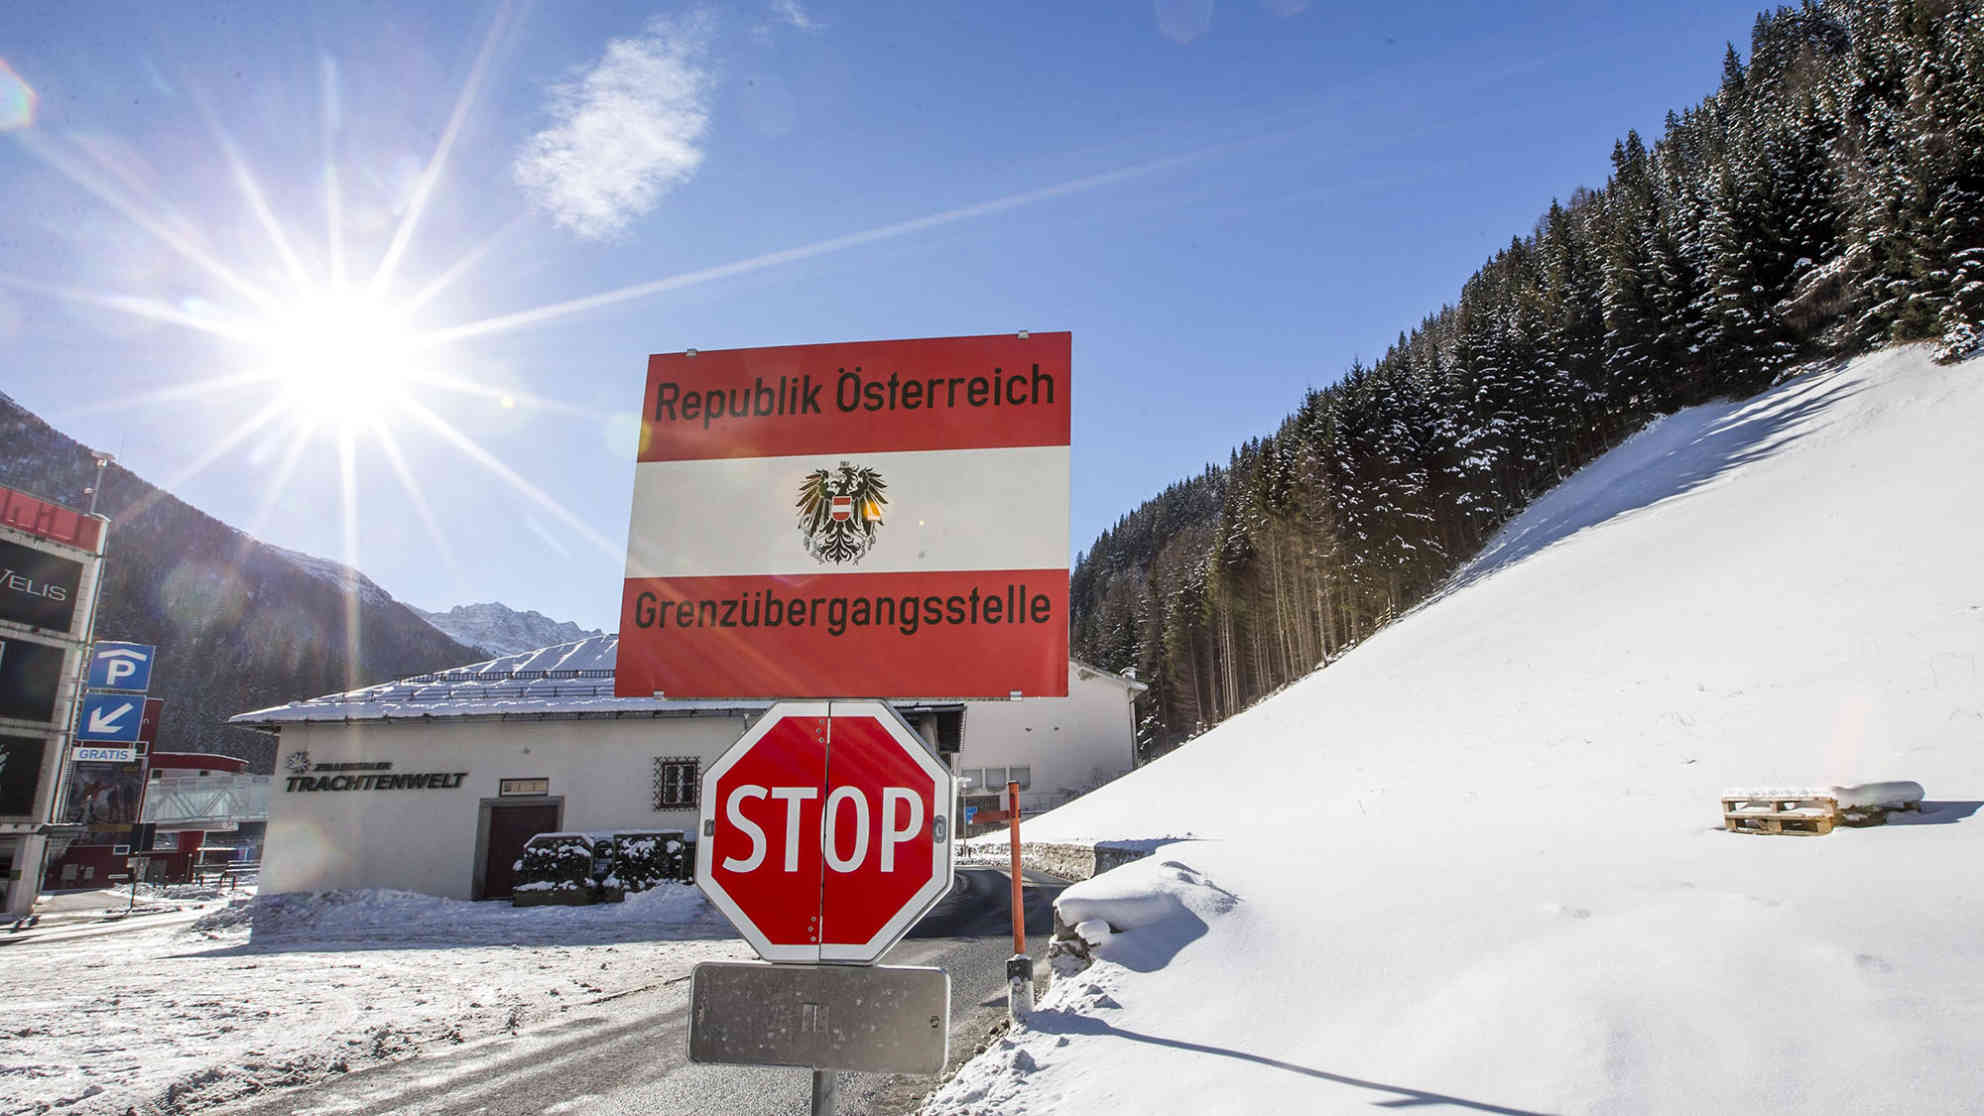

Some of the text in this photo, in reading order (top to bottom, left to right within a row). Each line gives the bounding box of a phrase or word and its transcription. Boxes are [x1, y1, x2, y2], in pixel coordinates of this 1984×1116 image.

[655, 363, 1054, 429] Republik Österreich
[635, 585, 1051, 637] Grenzübergangsstelle
[106, 659, 136, 685] P
[79, 749, 129, 761] GRATIS
[286, 772, 469, 793] TRACHTENWELT
[722, 784, 925, 873] STOP
